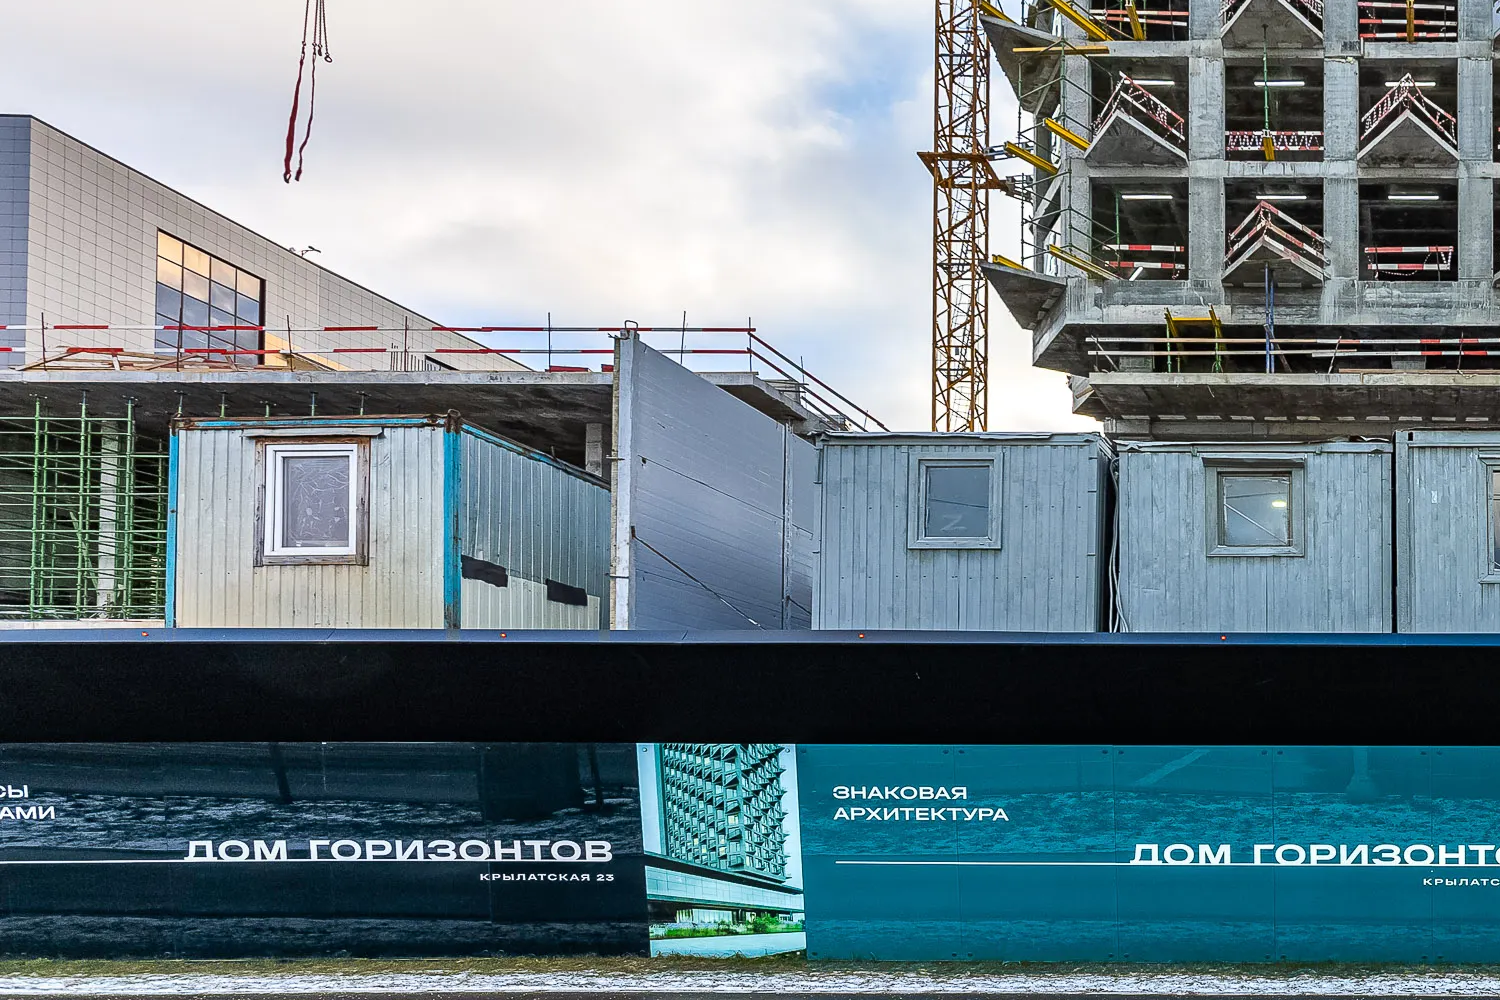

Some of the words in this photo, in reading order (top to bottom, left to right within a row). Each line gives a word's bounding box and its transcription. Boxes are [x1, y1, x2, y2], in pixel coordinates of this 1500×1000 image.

[833, 786, 967, 800] ЗНАКОВАЯ
[833, 807, 1009, 821] АРХИТЕКТУРА
[184, 840, 288, 862] ДОМ
[308, 840, 613, 862] ГОРИЗОНТОВ
[1130, 844, 1231, 866] ДОМ
[480, 873, 590, 882] КРЫЛАТСКАЯ
[596, 873, 615, 882] 23
